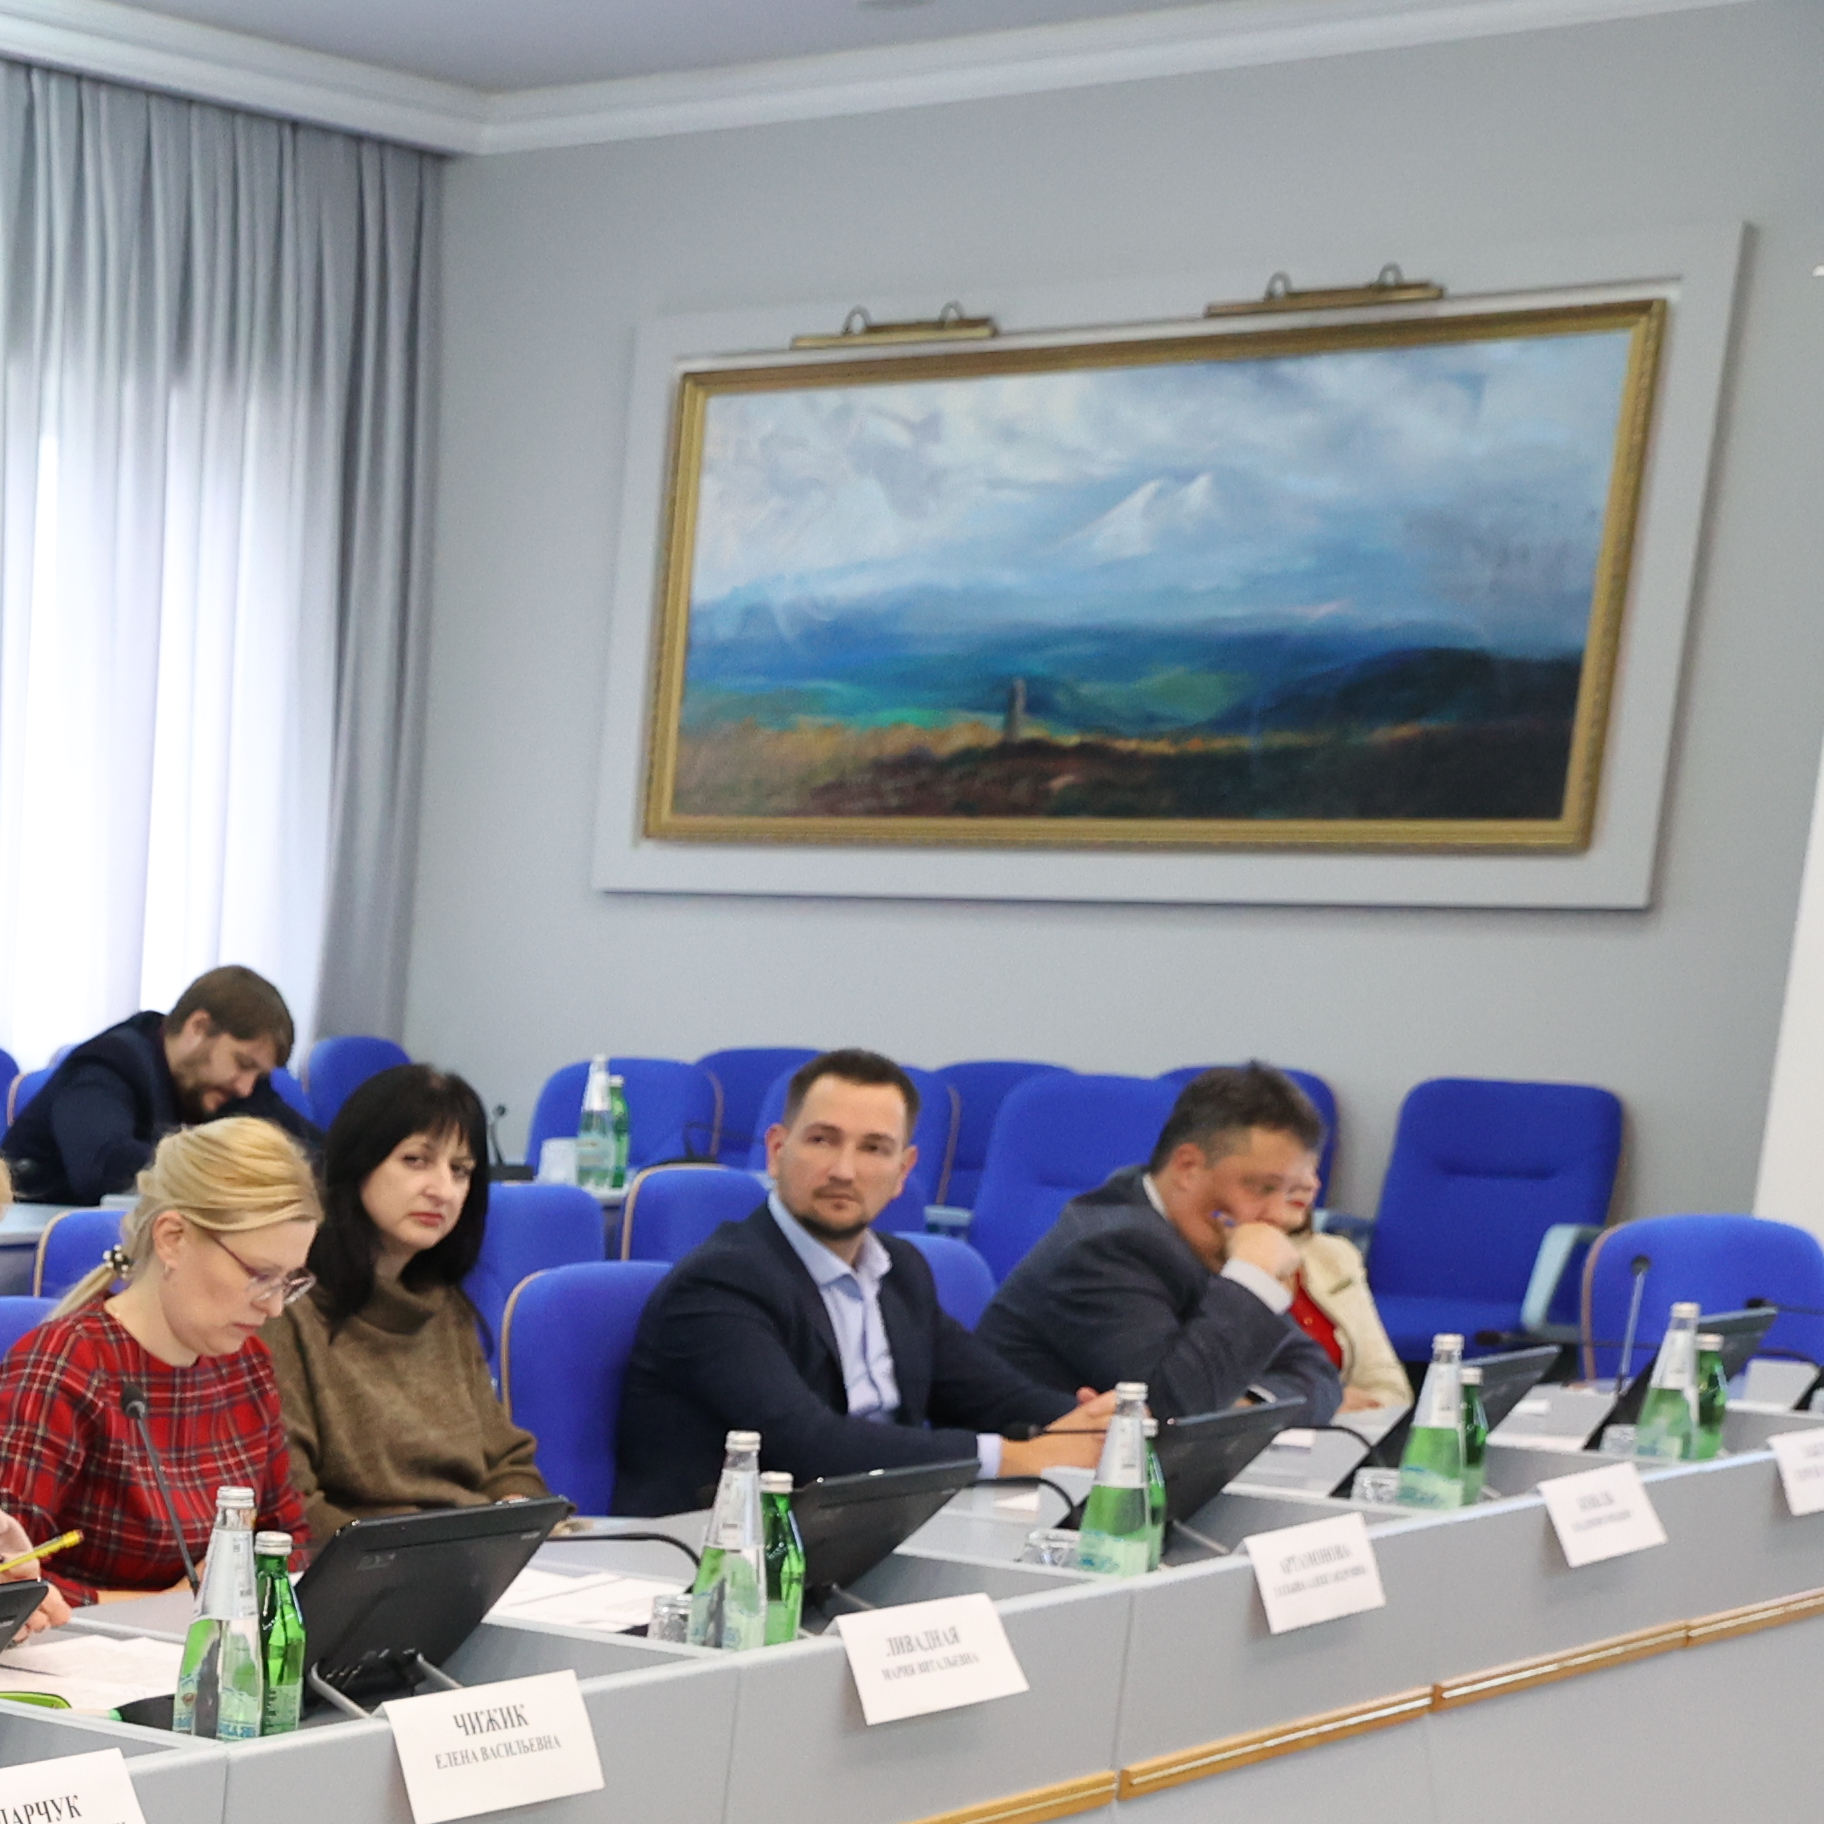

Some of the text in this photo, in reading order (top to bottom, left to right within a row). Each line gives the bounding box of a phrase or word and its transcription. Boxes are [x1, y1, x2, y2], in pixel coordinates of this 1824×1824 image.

[452, 1704, 529, 1736] ЧИЖИК
[435, 1735, 561, 1769] ЕЛЕНА ВАСИЛЬЕВНА
